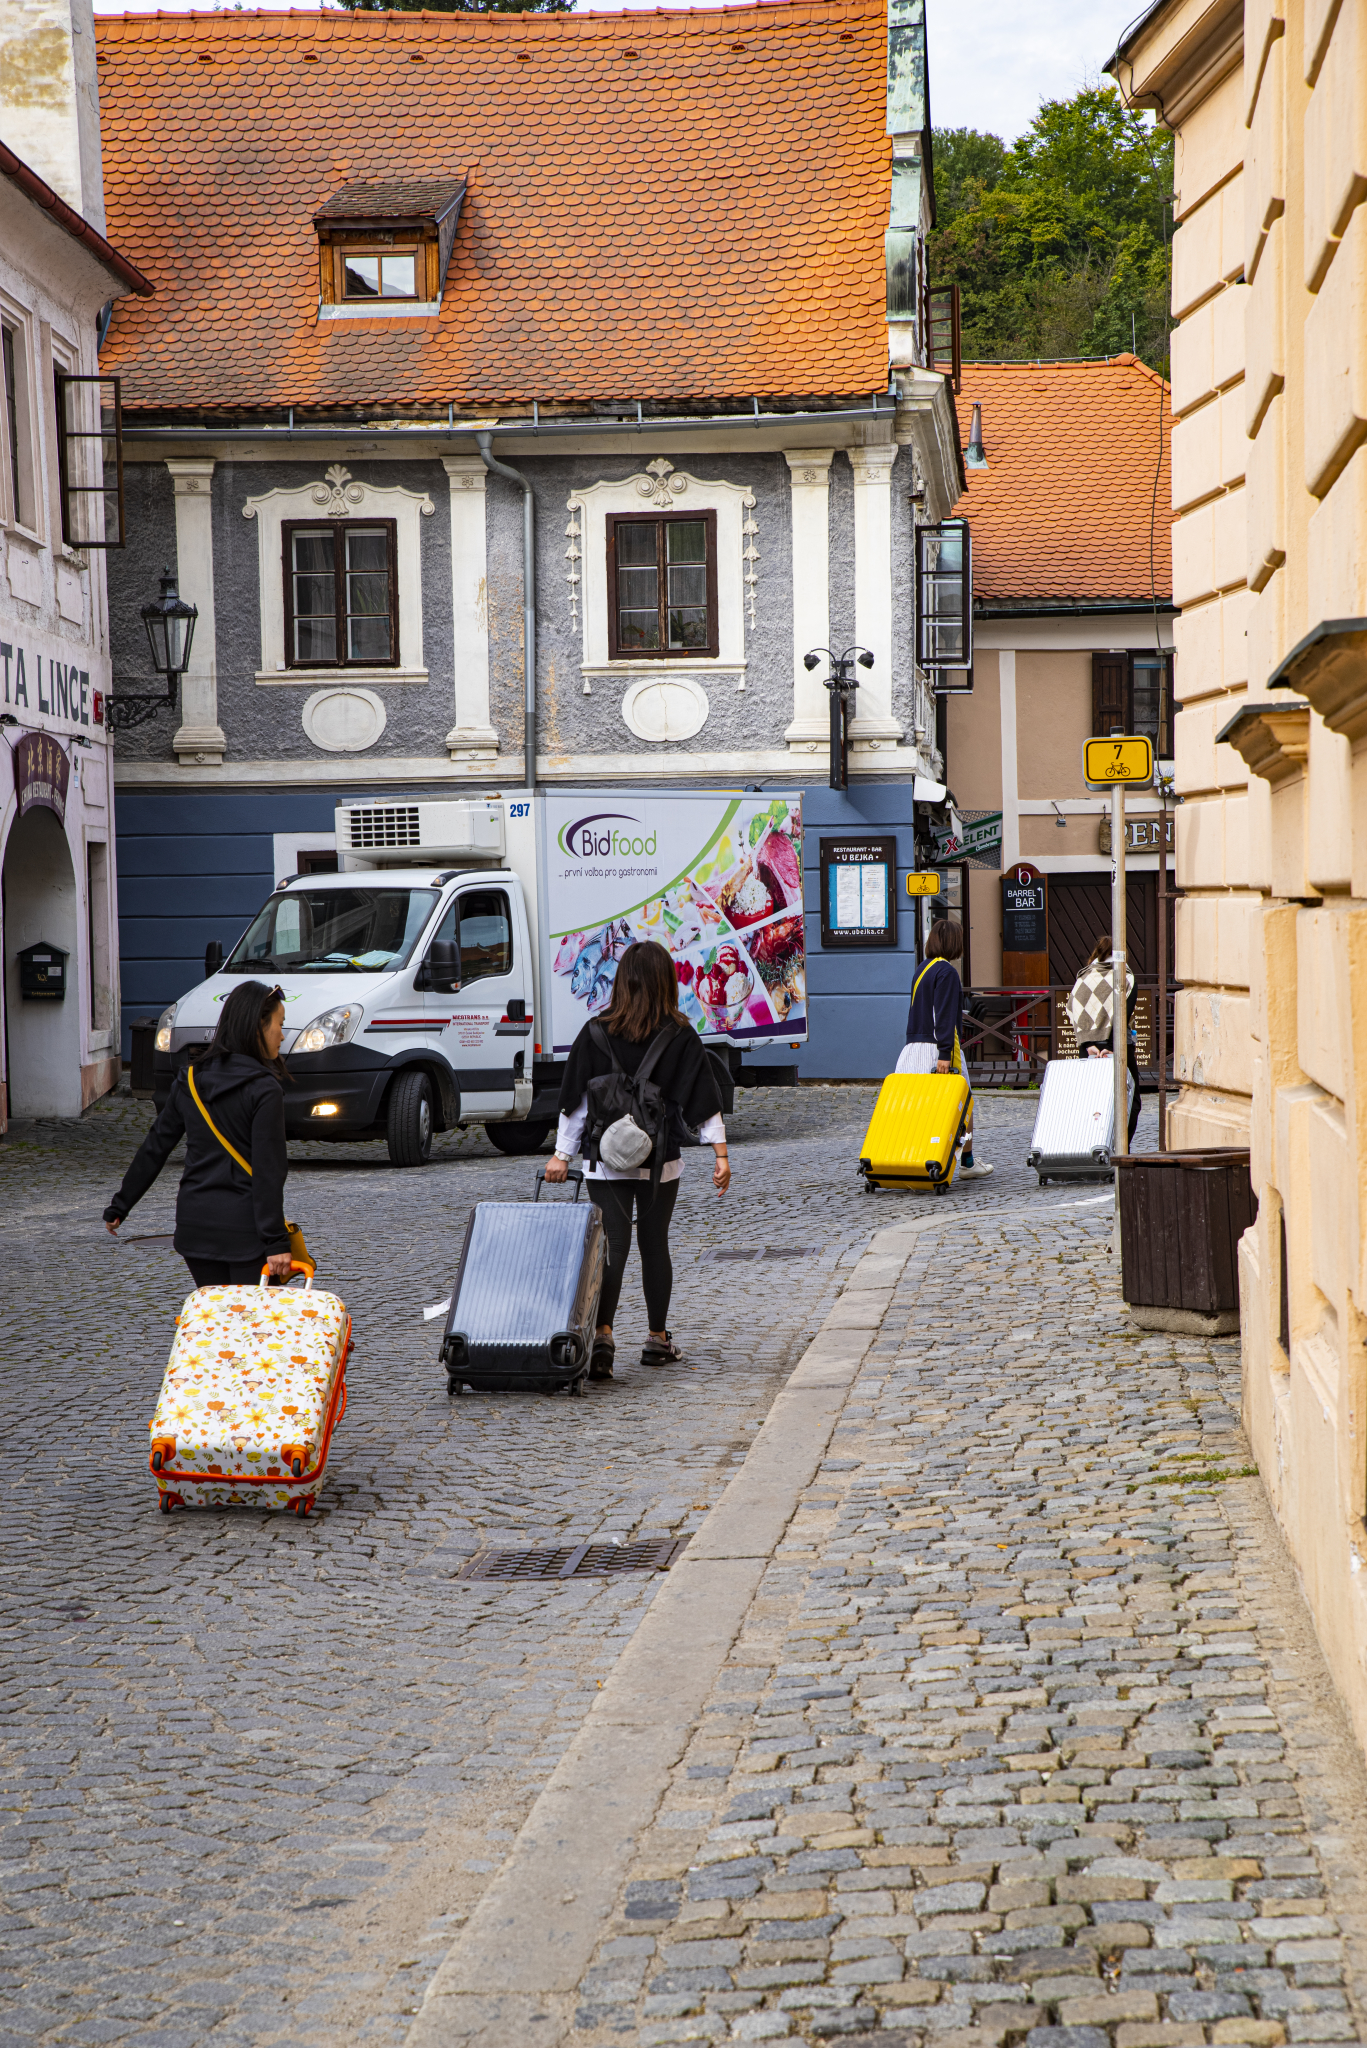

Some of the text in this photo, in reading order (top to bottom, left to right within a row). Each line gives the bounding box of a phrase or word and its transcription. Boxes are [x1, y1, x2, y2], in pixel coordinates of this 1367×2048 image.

[37, 654, 90, 726] LINCE
[1113, 744, 1123, 760] 7
[509, 803, 531, 818] 297
[582, 829, 657, 856] Bidfood
[849, 853, 874, 861] BEJKA
[564, 867, 583, 879] první
[584, 867, 604, 877] volba
[604, 869, 618, 879] pro
[618, 867, 658, 879] gastronomii
[921, 876, 927, 885] 7
[1007, 889, 1037, 898] BARREL
[1015, 897, 1036, 908] BAR
